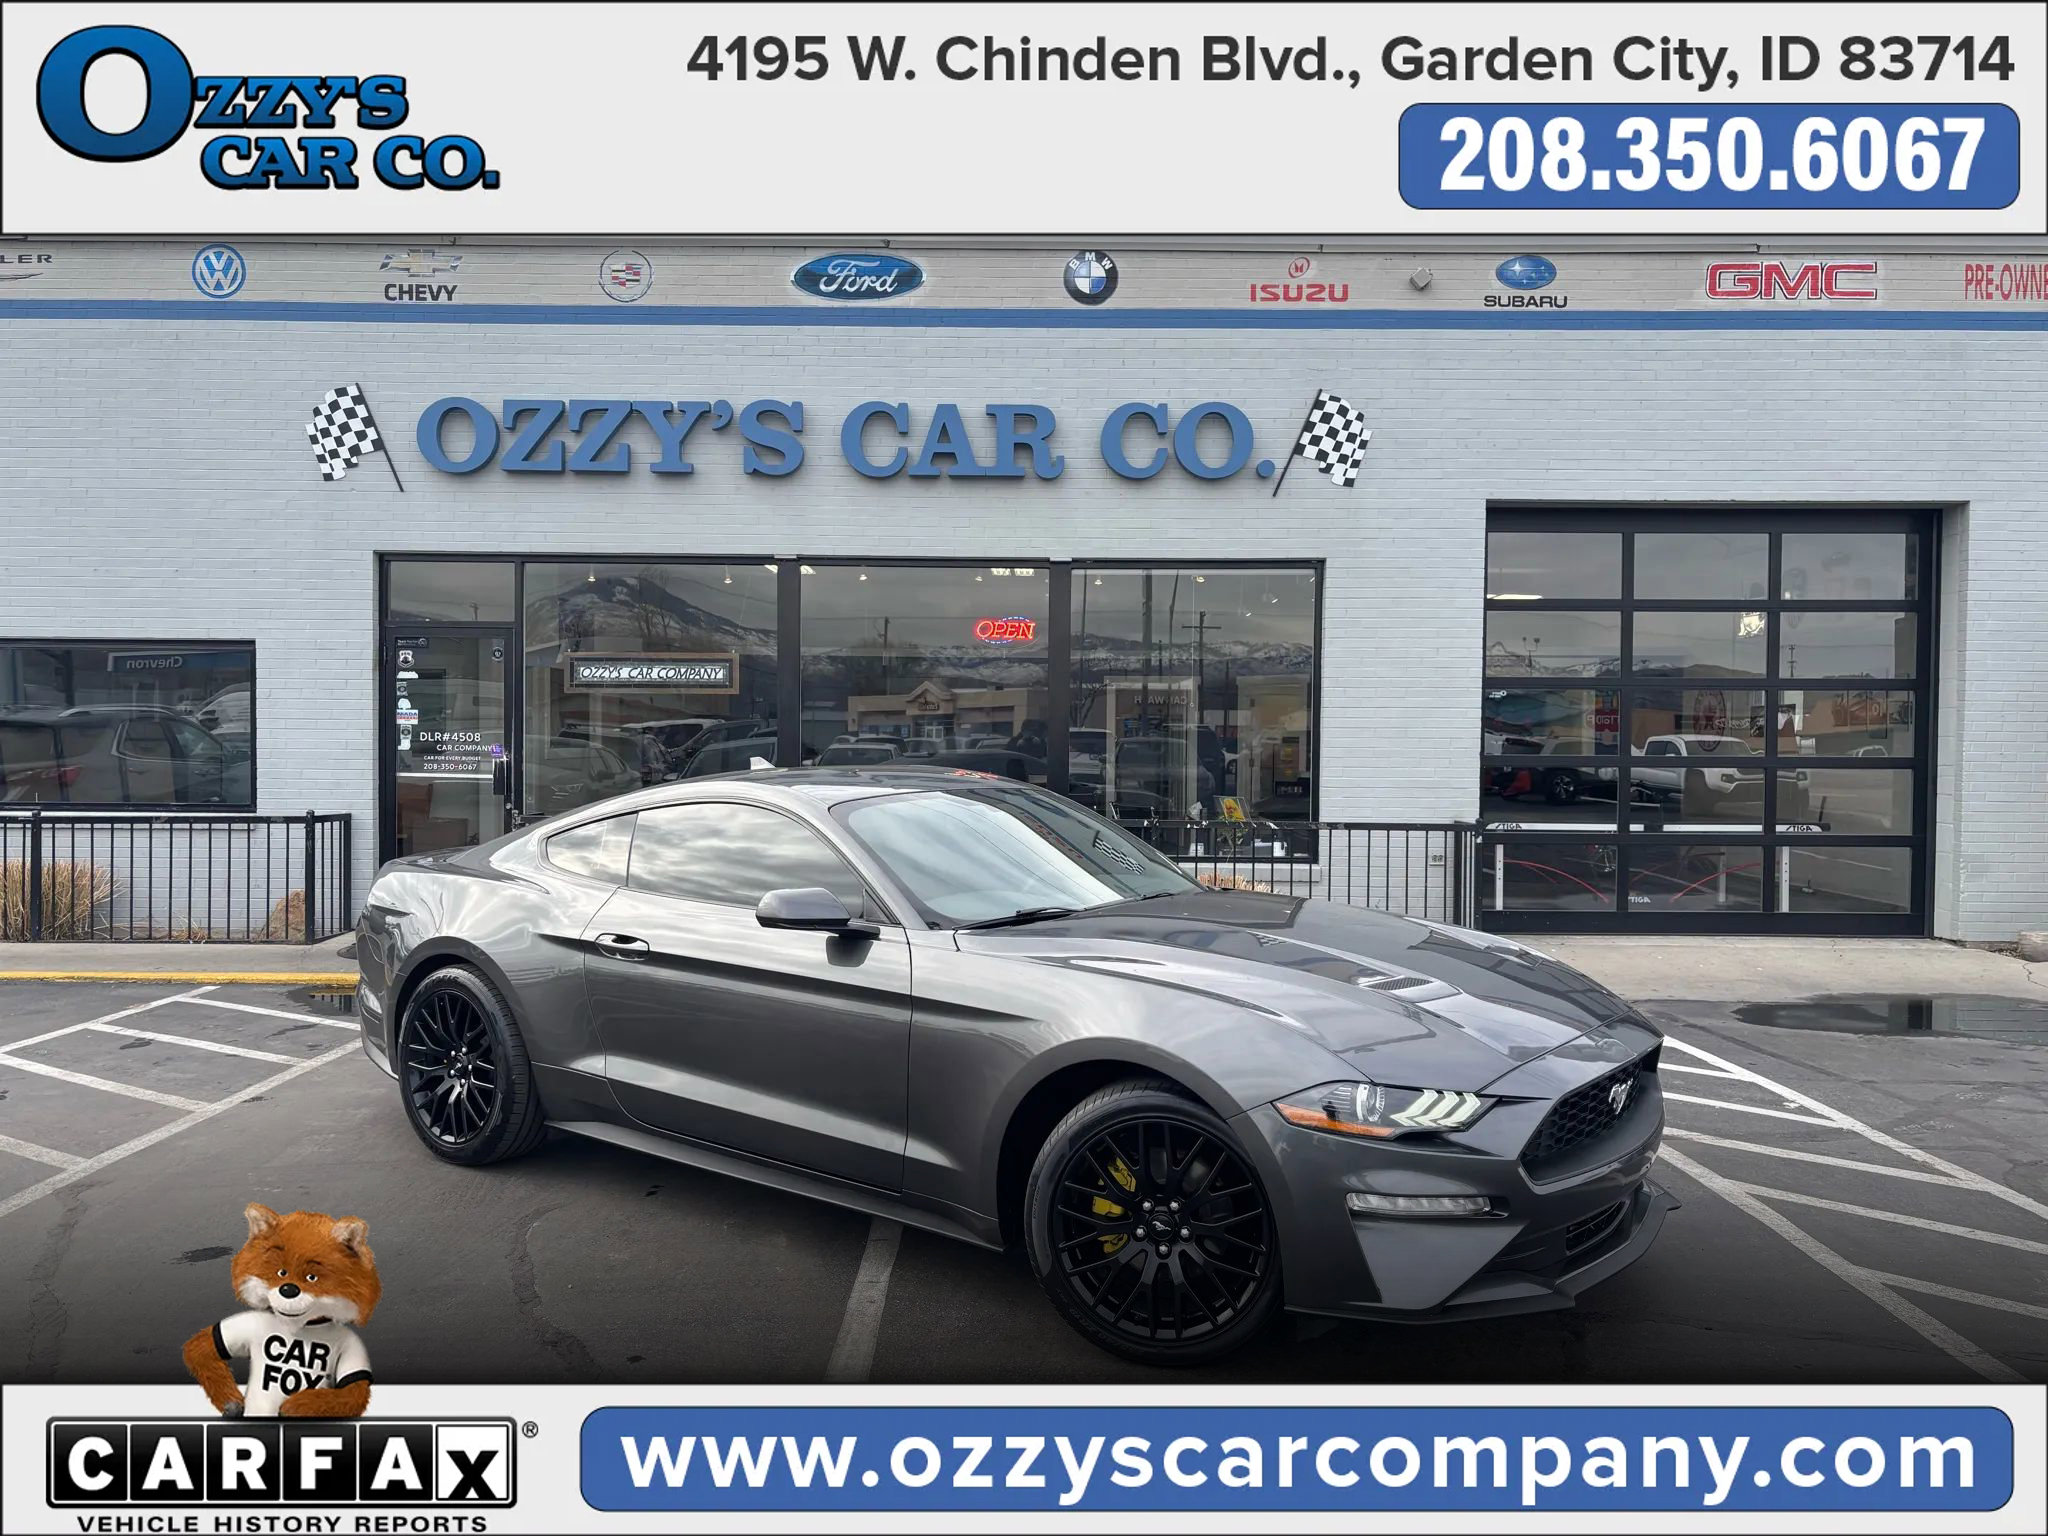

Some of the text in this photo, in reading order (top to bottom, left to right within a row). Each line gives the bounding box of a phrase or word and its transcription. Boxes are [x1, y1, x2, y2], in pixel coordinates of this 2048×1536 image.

[1069, 252, 1113, 270] BMW
[819, 259, 899, 293] Ford
[1706, 262, 1877, 299] GMC
[384, 284, 458, 302] CHEVY
[1250, 283, 1349, 302] ISUZU
[1484, 295, 1568, 308] SUBARU
[416, 397, 1276, 480] OZZY'S CAR CO.
[976, 620, 1036, 639] OPEN
[581, 667, 722, 680] OZZY'S CAR COMPANY
[420, 732, 481, 741] DLR#4508
[454, 744, 493, 752] COMPANY
